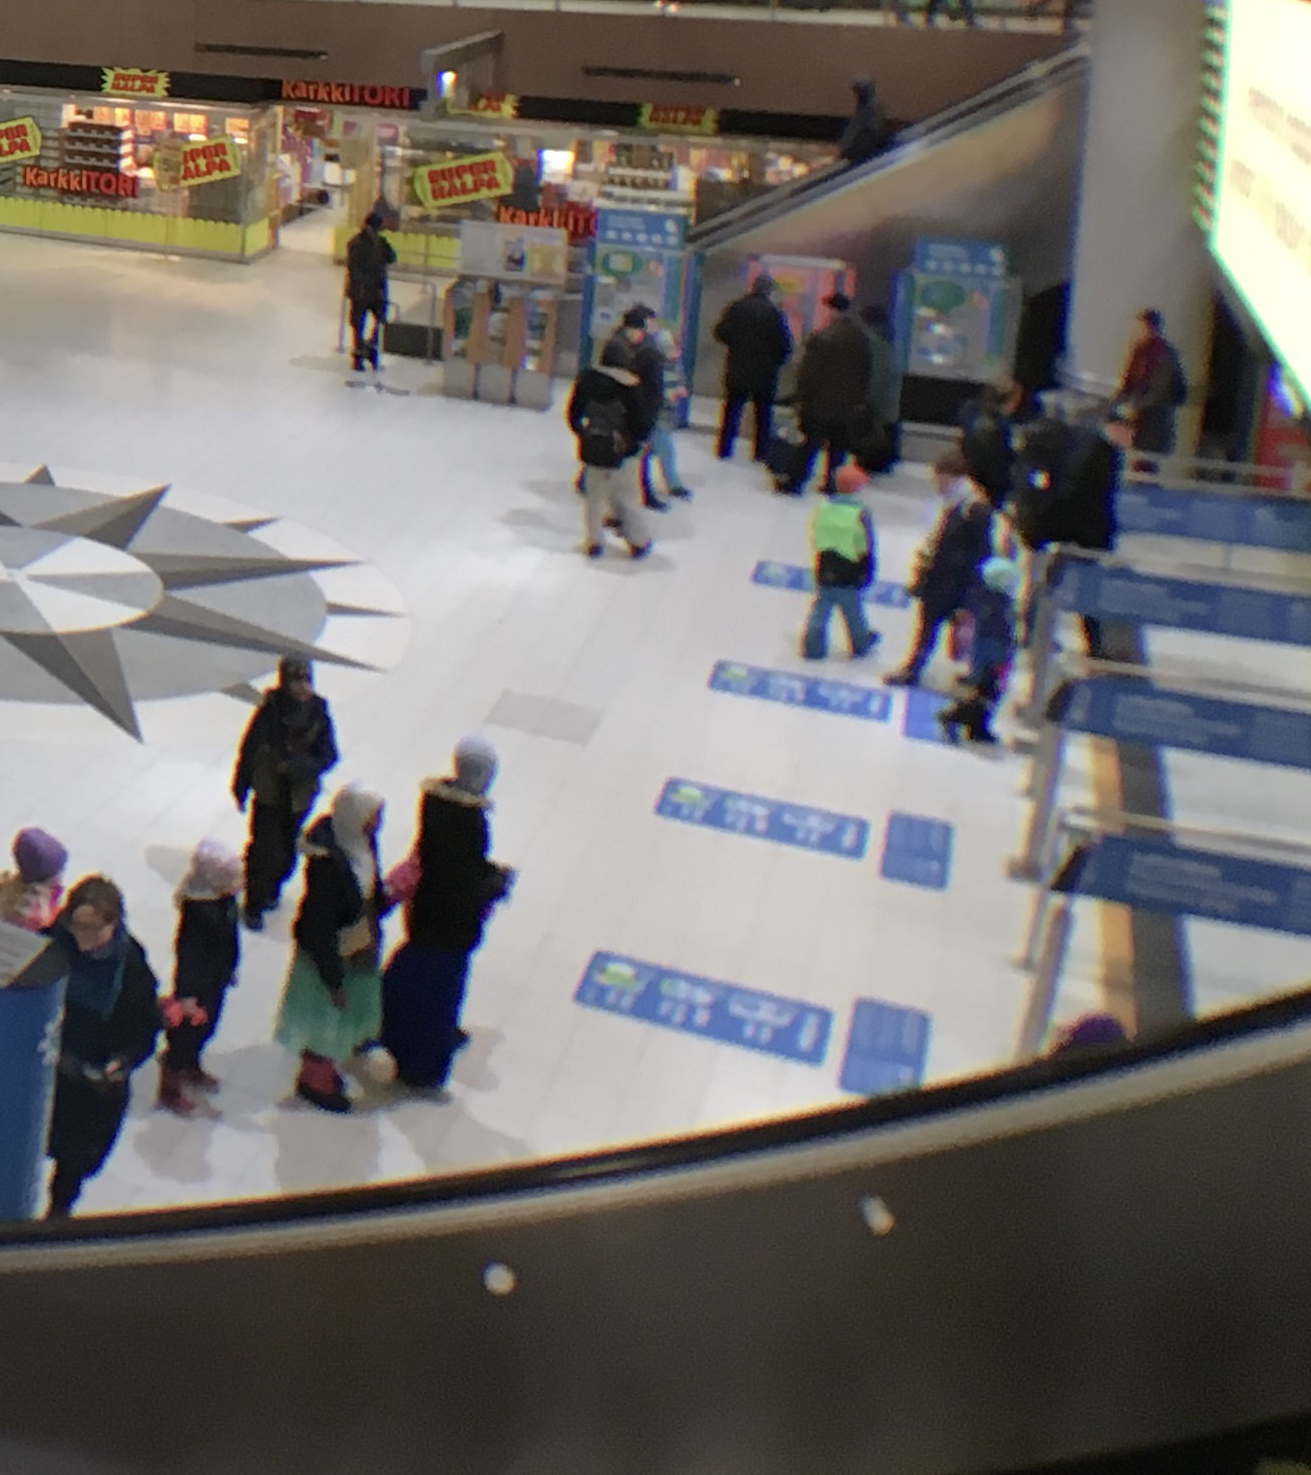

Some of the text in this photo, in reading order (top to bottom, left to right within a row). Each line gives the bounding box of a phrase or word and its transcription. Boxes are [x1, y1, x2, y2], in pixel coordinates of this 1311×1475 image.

[281, 80, 410, 108] KarkkiTORI
[24, 166, 139, 198] KarkkiTORI
[181, 157, 231, 180] ALPA
